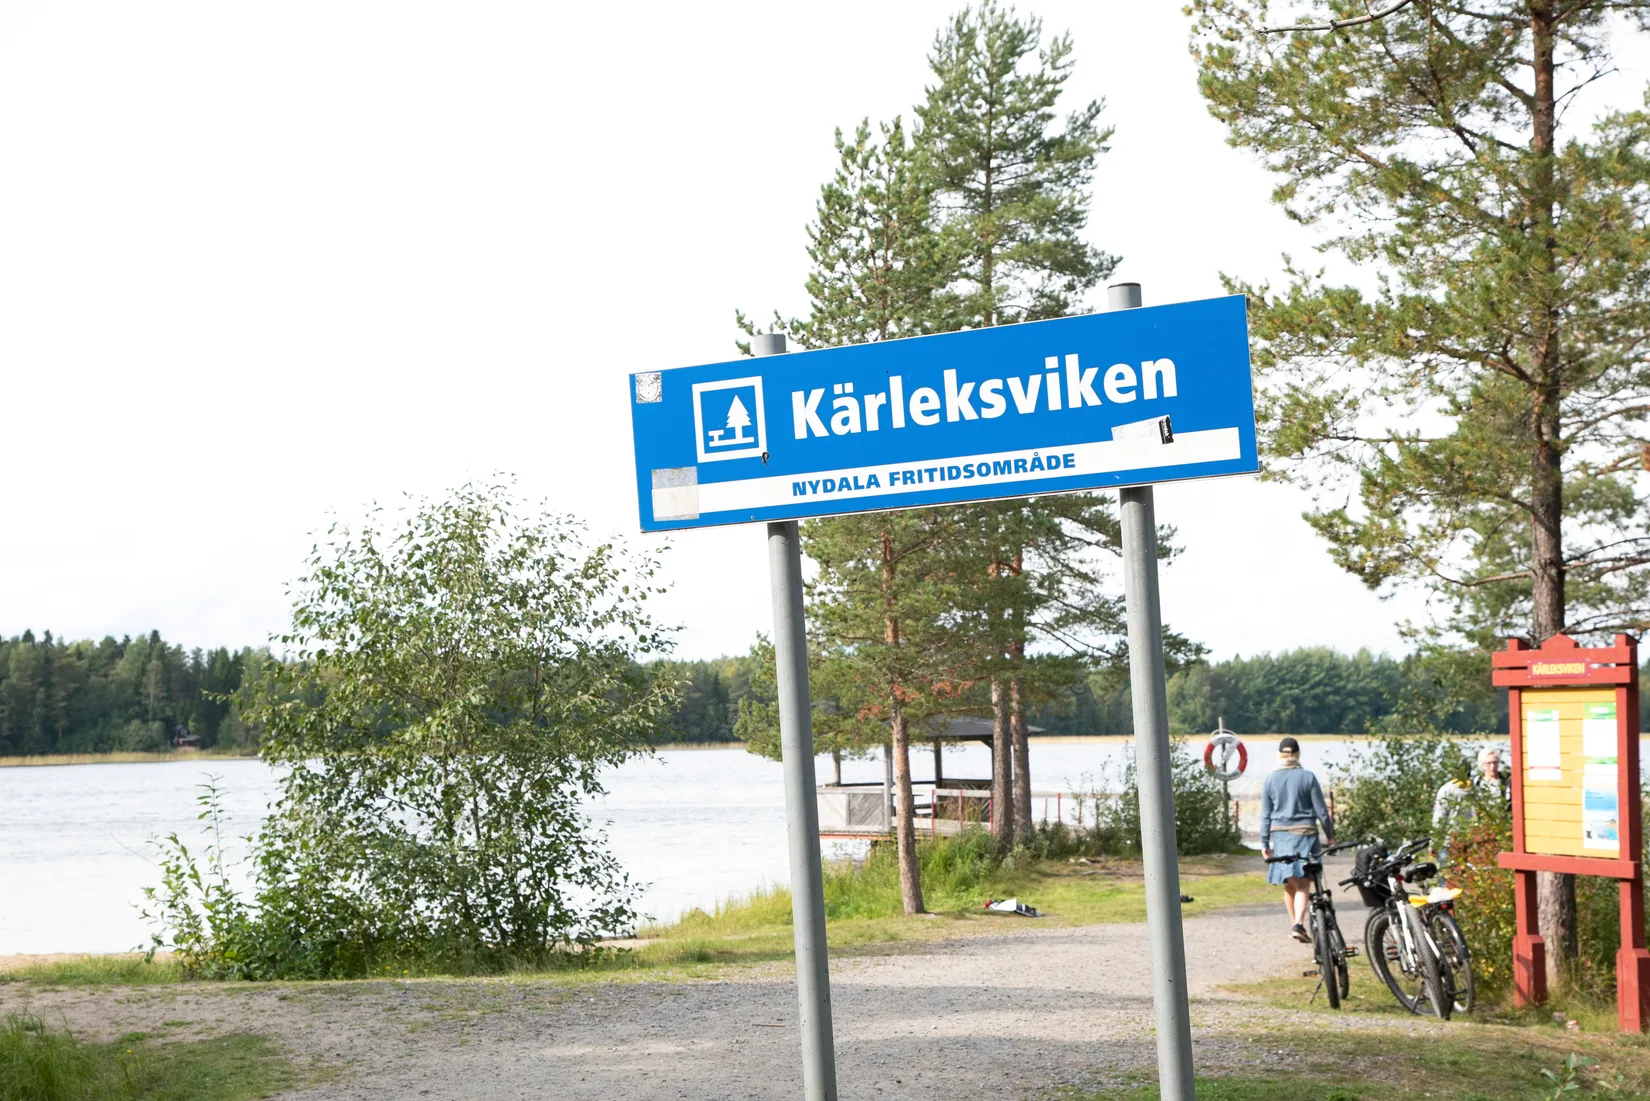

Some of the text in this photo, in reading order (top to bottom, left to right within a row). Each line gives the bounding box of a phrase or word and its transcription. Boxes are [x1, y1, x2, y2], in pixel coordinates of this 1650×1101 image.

[791, 353, 1178, 440] Kärleksviken
[792, 451, 1076, 496] NYDALA FRITIDSOMRÅDE
